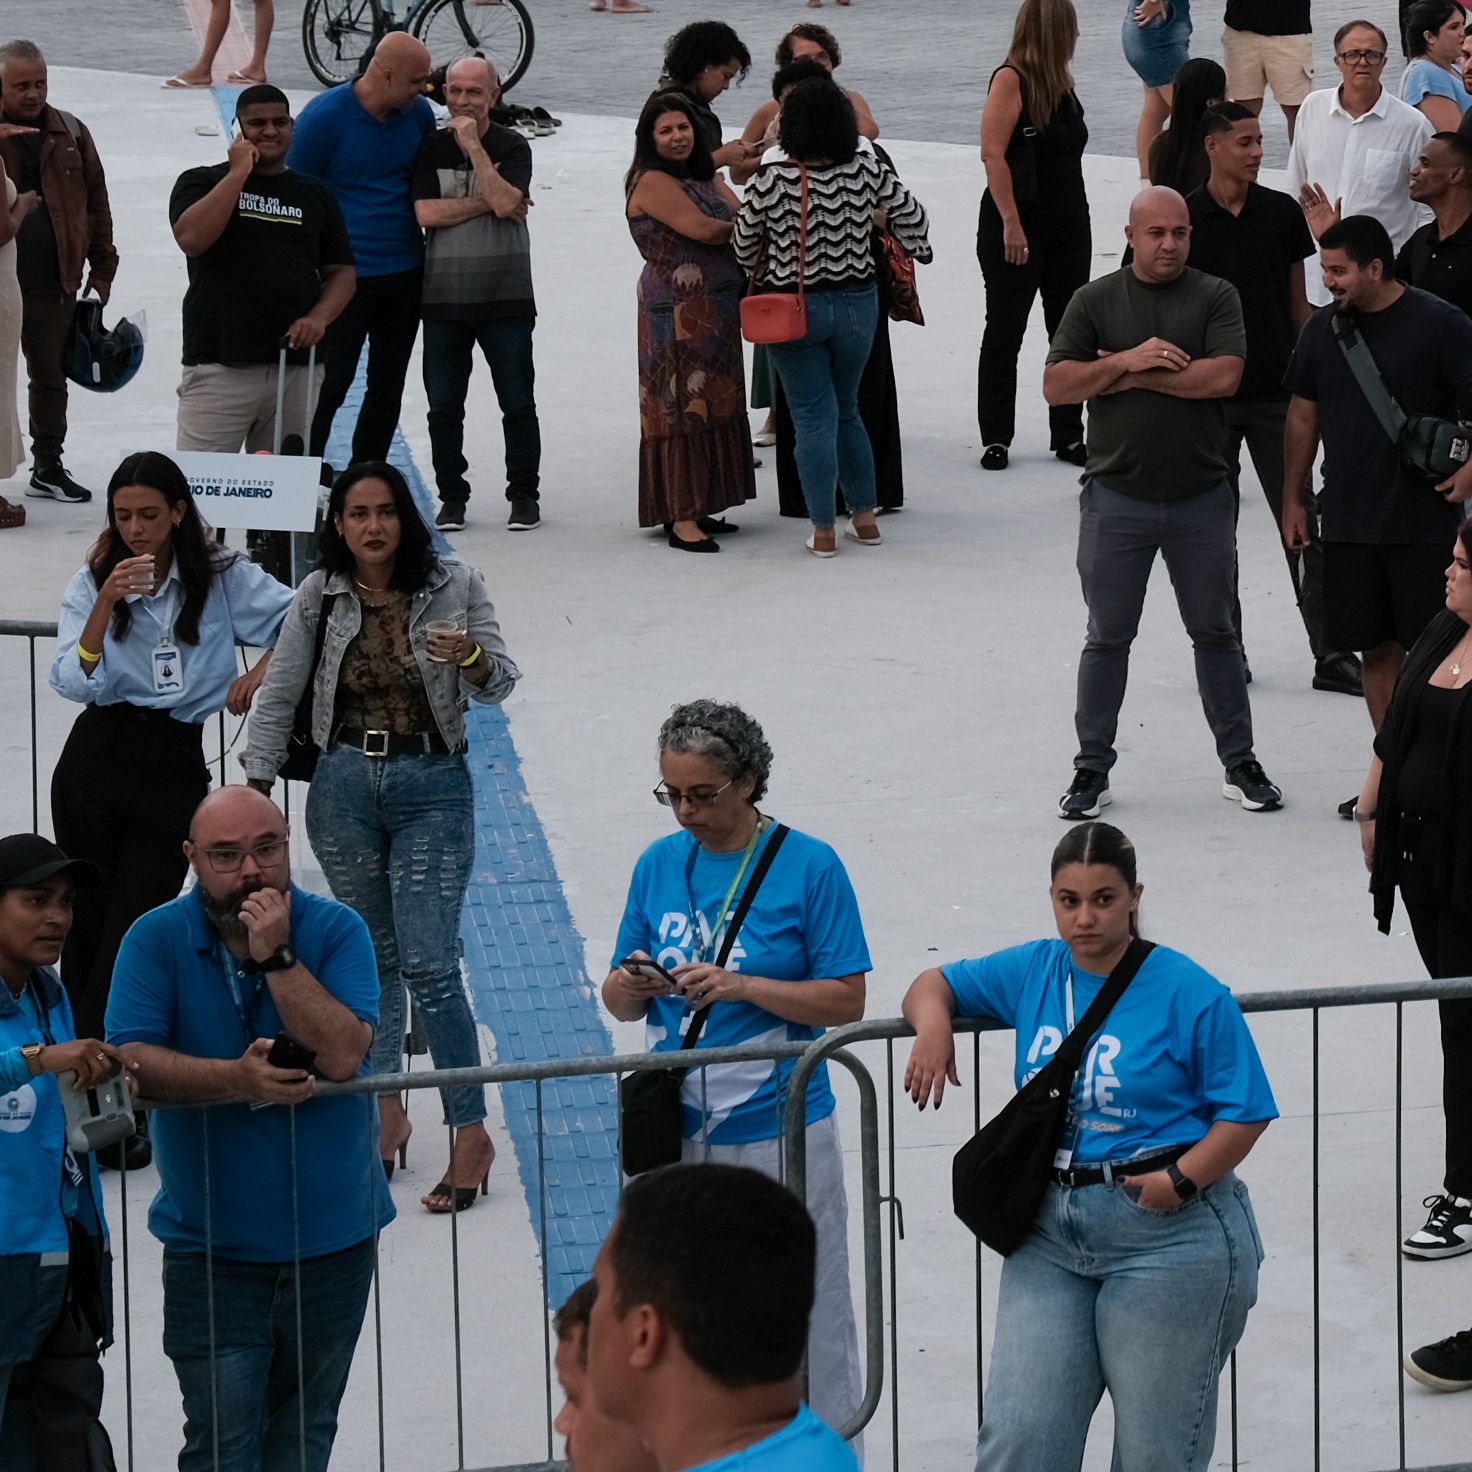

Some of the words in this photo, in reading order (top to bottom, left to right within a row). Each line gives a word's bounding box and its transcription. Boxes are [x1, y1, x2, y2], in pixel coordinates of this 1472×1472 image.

[240, 192, 265, 204] TROPA
[267, 197, 280, 206] DO
[238, 199, 303, 218] BOLSONARO
[205, 486, 221, 496] DE
[223, 486, 273, 498] JANEIRO
[1027, 1026, 1121, 1075] PR
[1123, 1108, 1136, 1118] RJ
